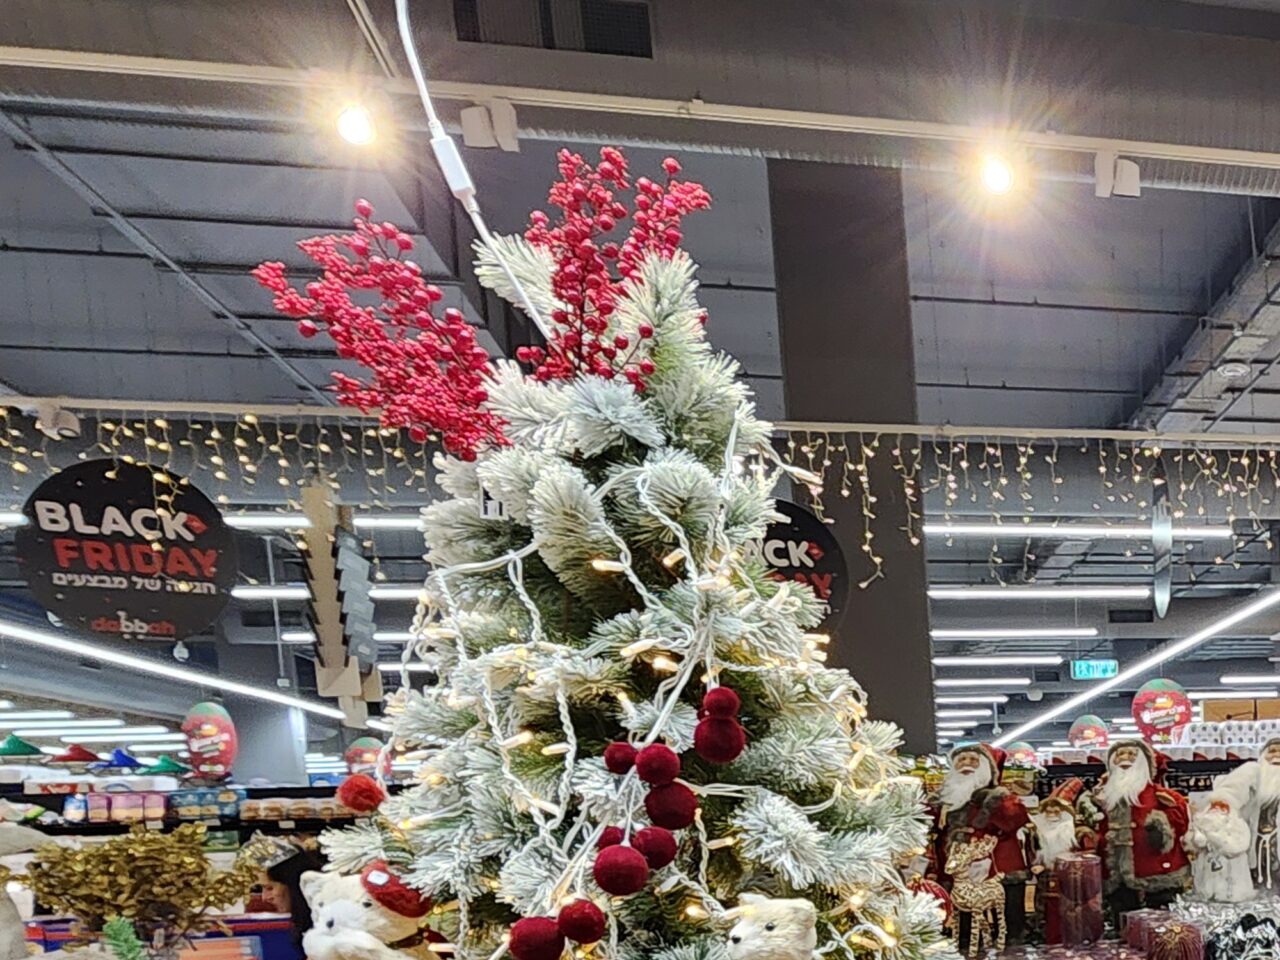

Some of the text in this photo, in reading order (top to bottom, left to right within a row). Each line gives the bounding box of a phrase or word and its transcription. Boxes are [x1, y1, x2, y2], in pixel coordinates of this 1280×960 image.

[34, 500, 195, 542] BLACK
[52, 538, 217, 578] FRIDAY
[744, 539, 815, 568] ACK
[51, 572, 216, 595] חגיה של מבצעים
